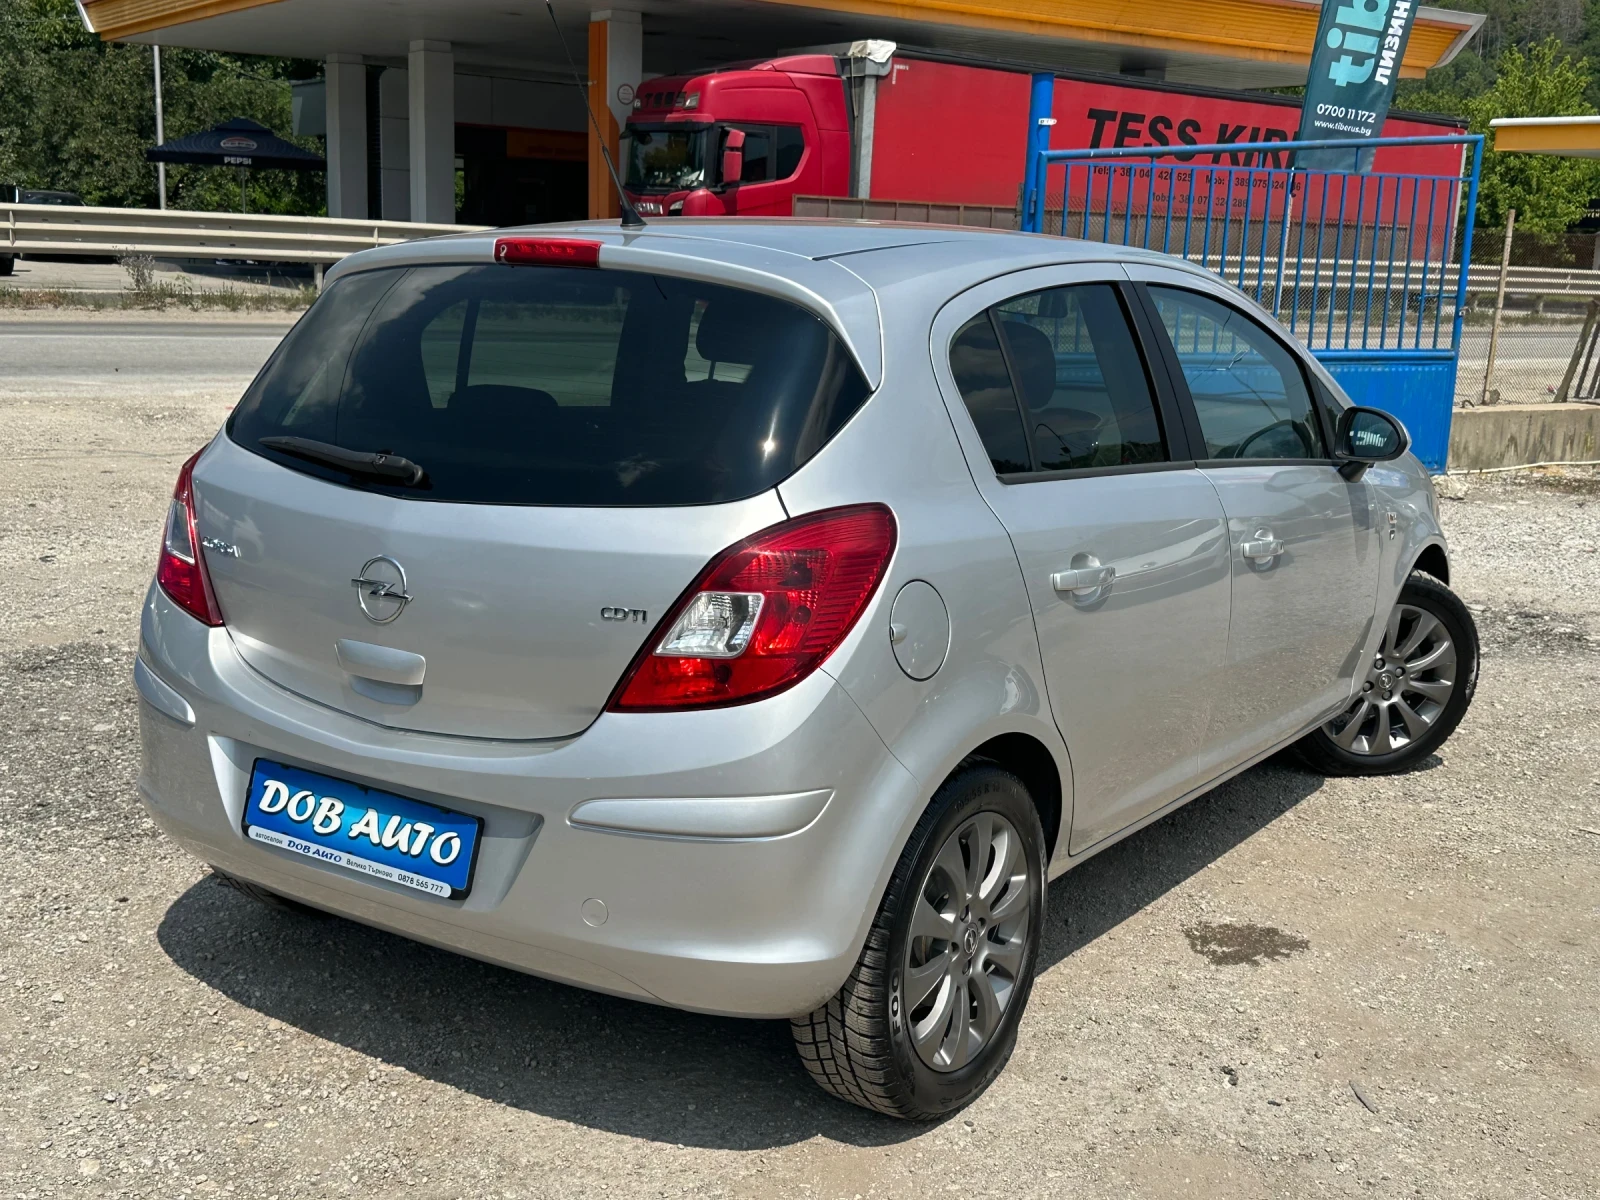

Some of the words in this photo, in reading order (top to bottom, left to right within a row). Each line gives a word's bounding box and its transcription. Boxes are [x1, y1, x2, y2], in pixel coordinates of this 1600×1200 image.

[1327, 0, 1390, 87] tib
[1374, 0, 1411, 86] ЛИЗИН
[1087, 107, 1202, 162] TESS
[1314, 119, 1372, 137] www.tiberus.bg
[1316, 103, 1346, 119] 0700
[1347, 108, 1356, 120] 11
[1357, 110, 1377, 123] 172
[223, 156, 252, 165] PEPSI
[601, 606, 647, 624] CDTI
[258, 779, 345, 834] DOB
[347, 807, 462, 865] AUTO
[287, 839, 311, 854] DOB
[312, 848, 342, 863] AUTO
[346, 858, 367, 871] Велико
[368, 864, 393, 878] Търново
[397, 873, 414, 885] 0878
[415, 879, 429, 889] 565
[430, 883, 444, 893] 777
